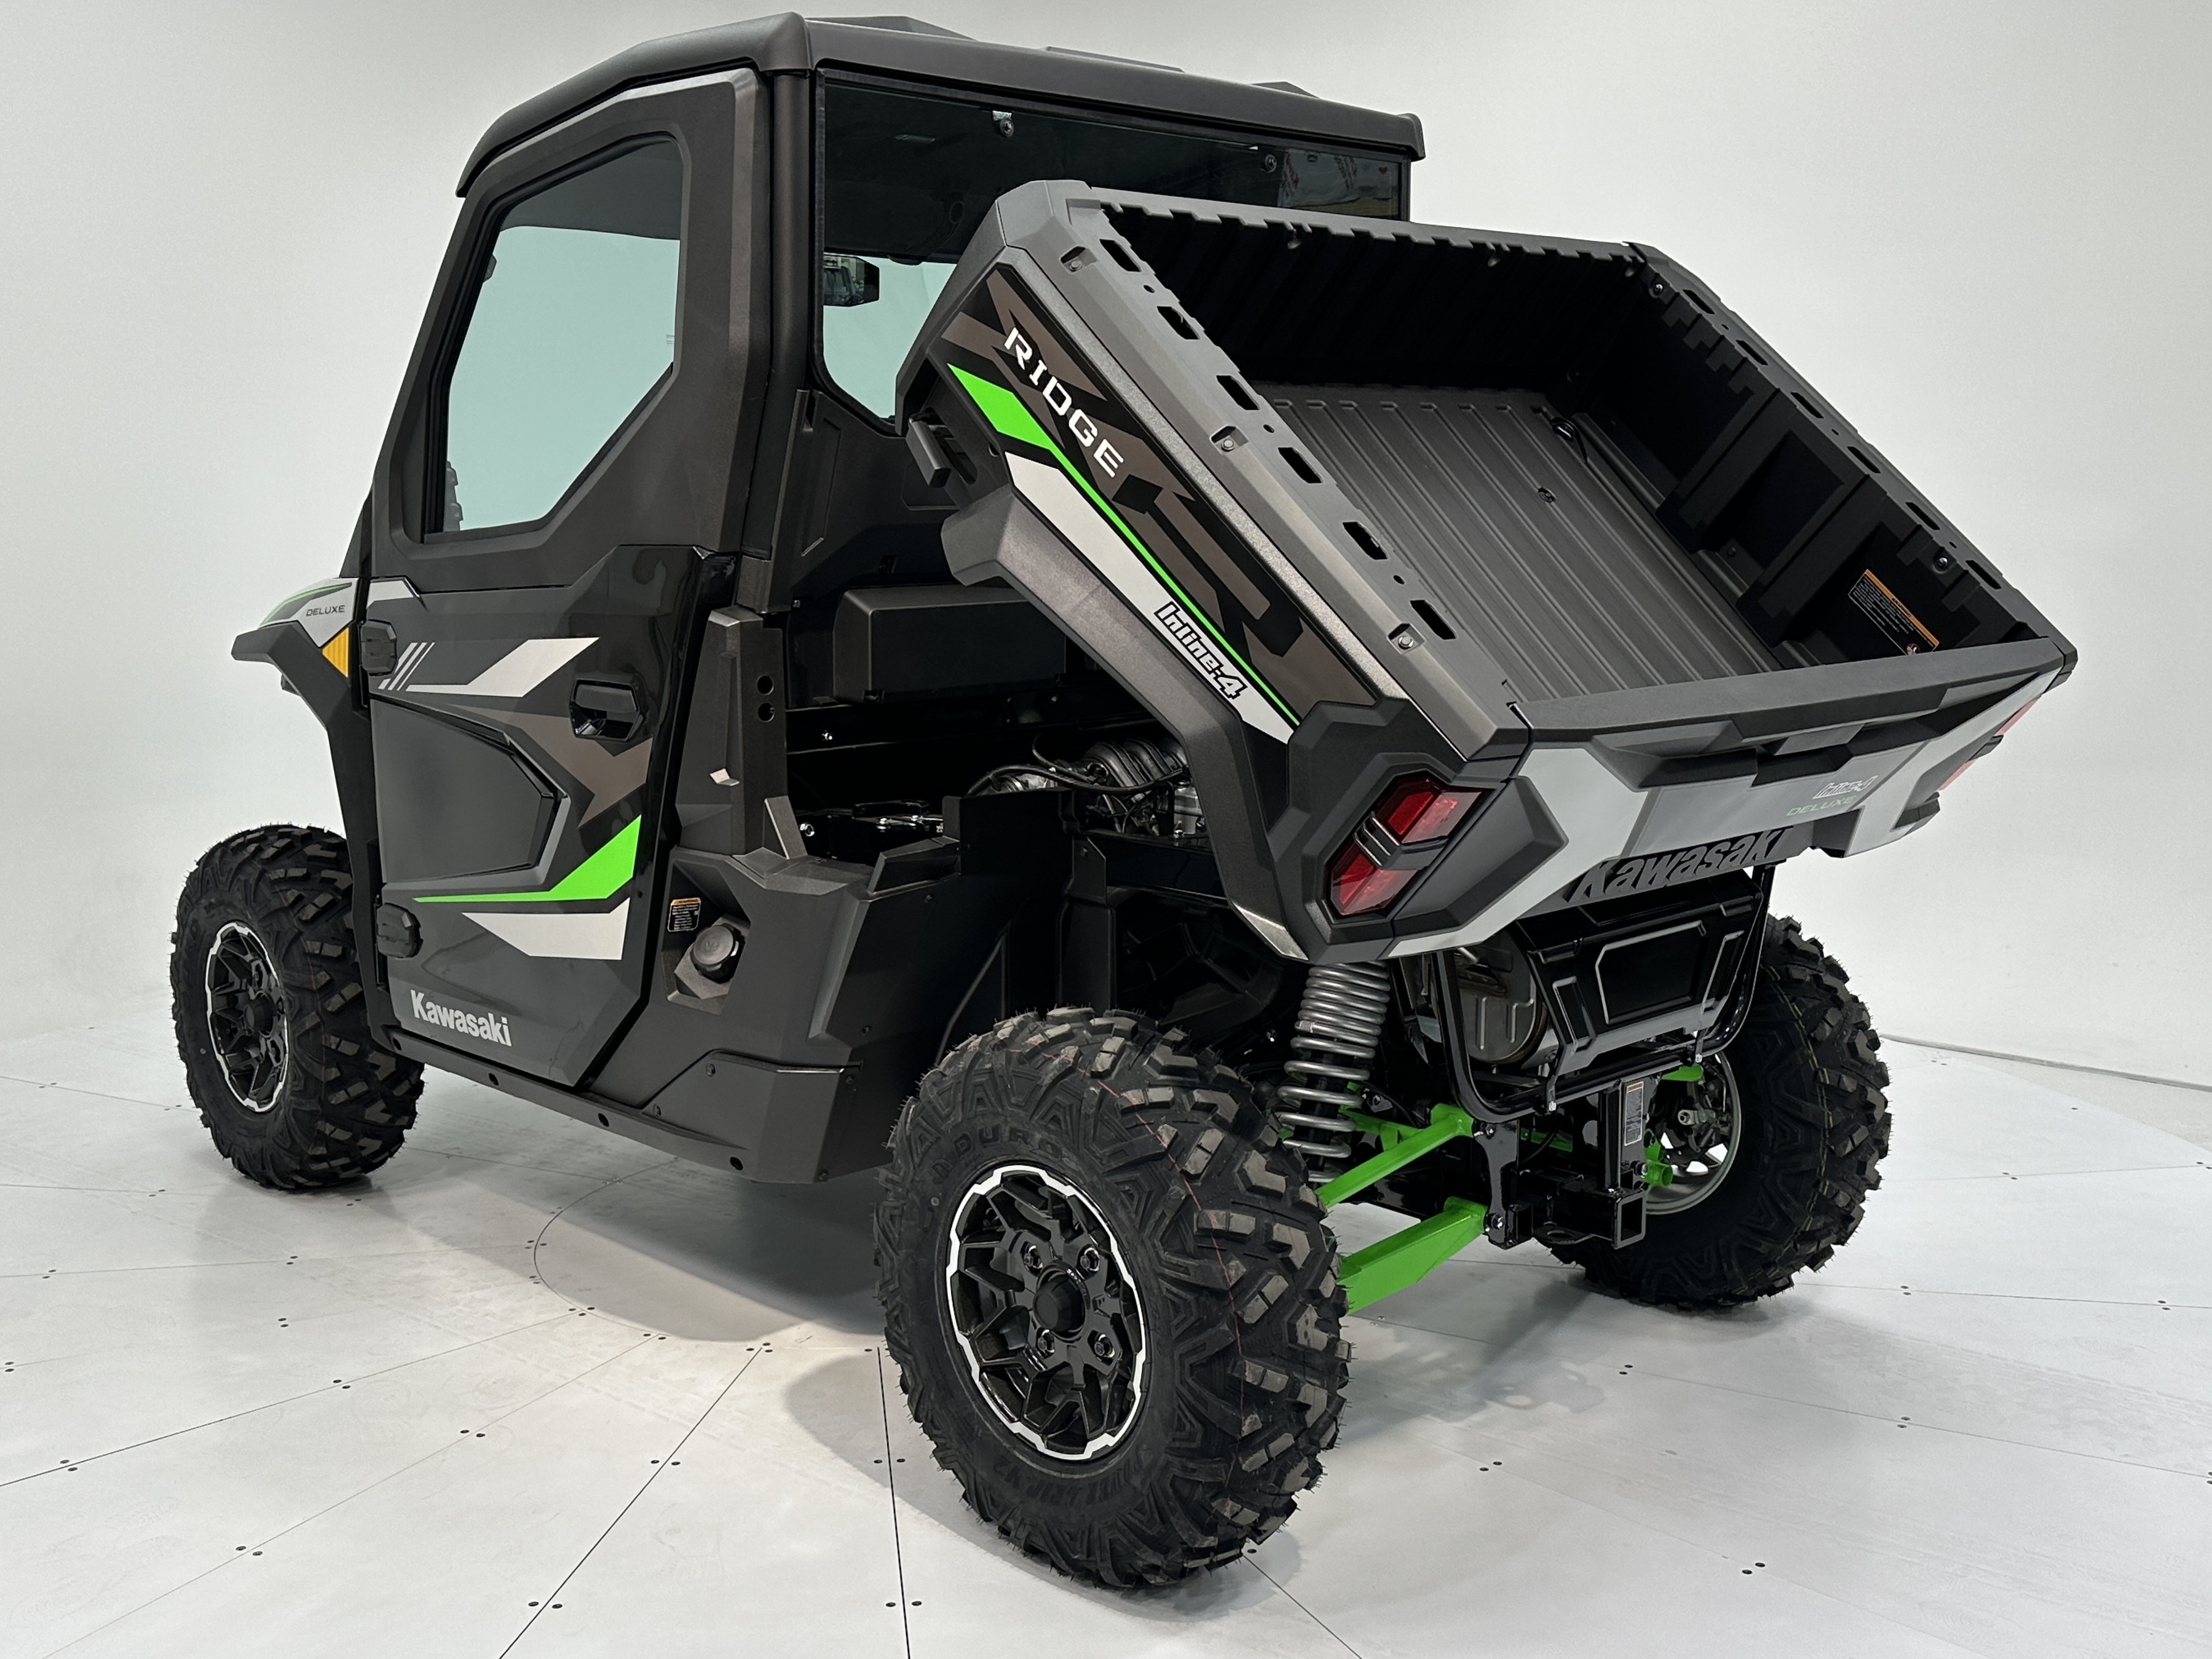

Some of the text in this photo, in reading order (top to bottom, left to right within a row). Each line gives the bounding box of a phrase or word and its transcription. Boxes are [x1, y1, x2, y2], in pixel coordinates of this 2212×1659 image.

[1004, 327, 1124, 478] RIDGE
[306, 605, 346, 617] DELUXE
[1153, 601, 1248, 700] Inline-4
[1787, 795, 1857, 817] DELUXE
[411, 989, 512, 1047] Kawasaki
